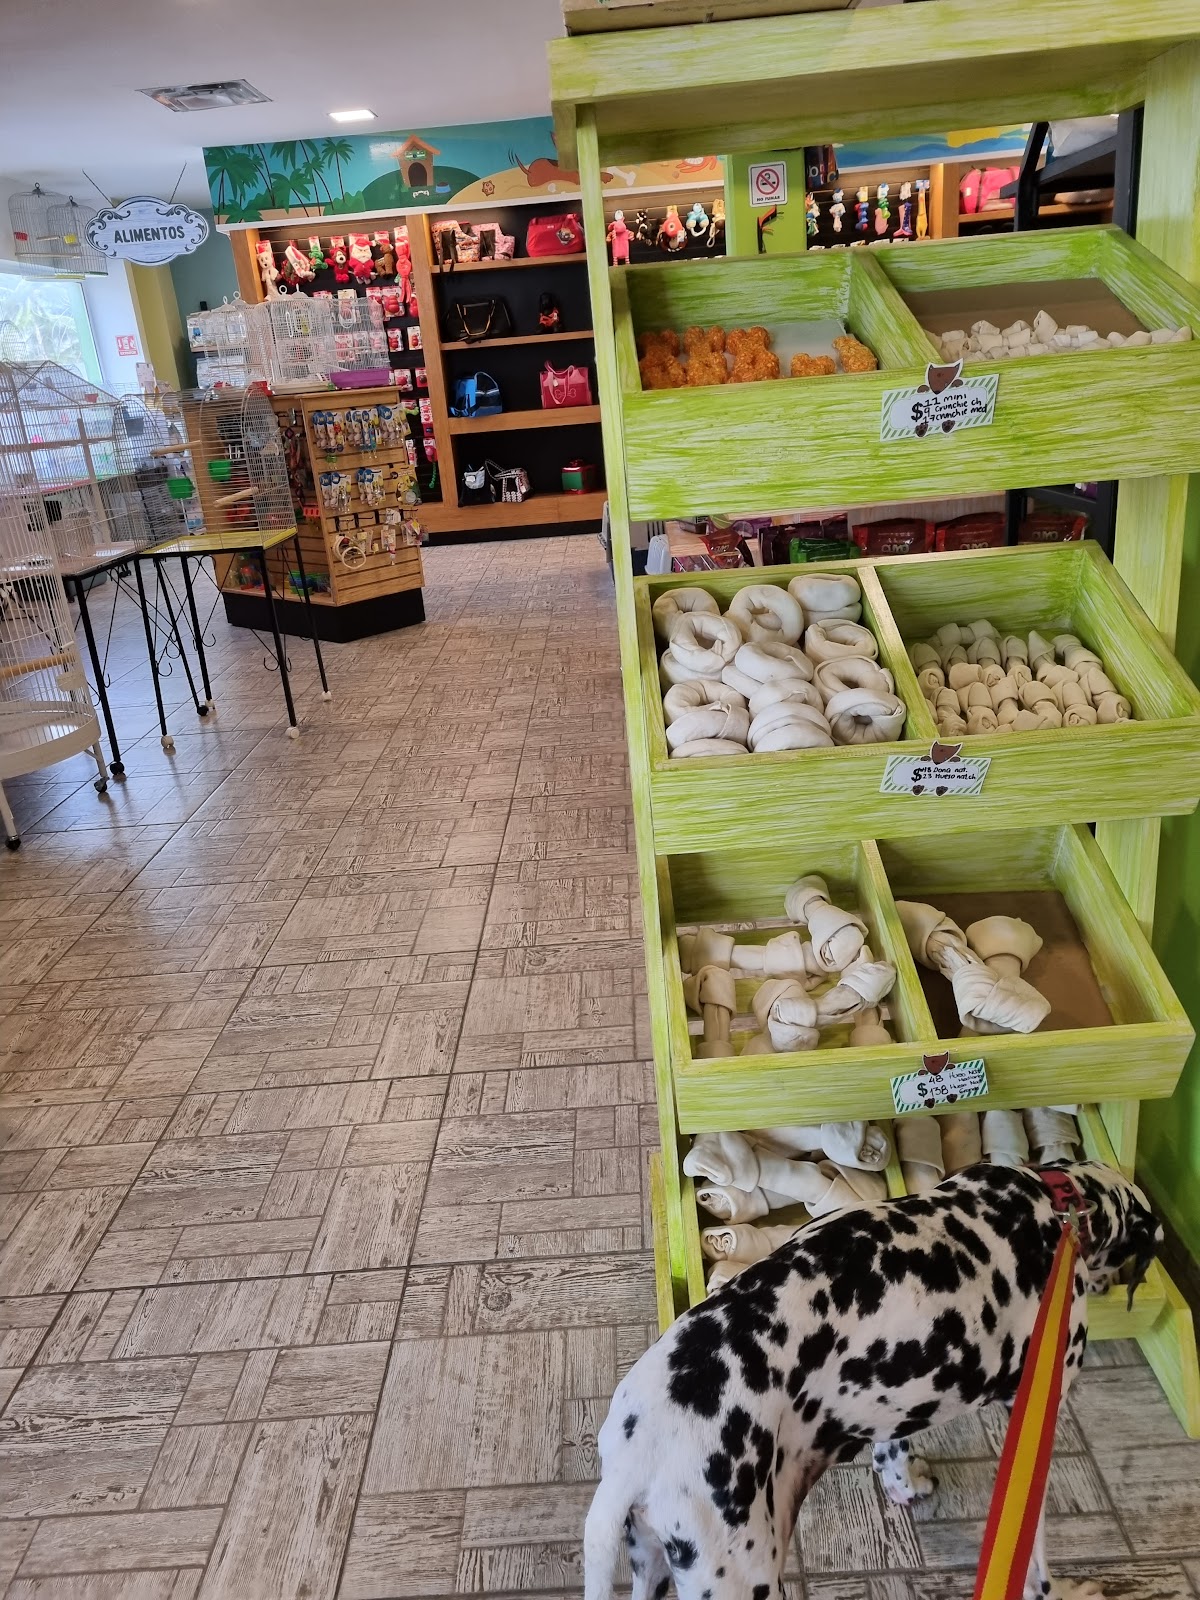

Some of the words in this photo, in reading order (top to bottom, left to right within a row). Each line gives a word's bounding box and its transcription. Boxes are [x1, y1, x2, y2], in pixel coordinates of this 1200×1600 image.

[114, 226, 185, 243] ALIMENTOS
[944, 394, 967, 402] mini
[929, 1075, 943, 1084] 48
[917, 1082, 928, 1098] $
[930, 1084, 948, 1097] 138
